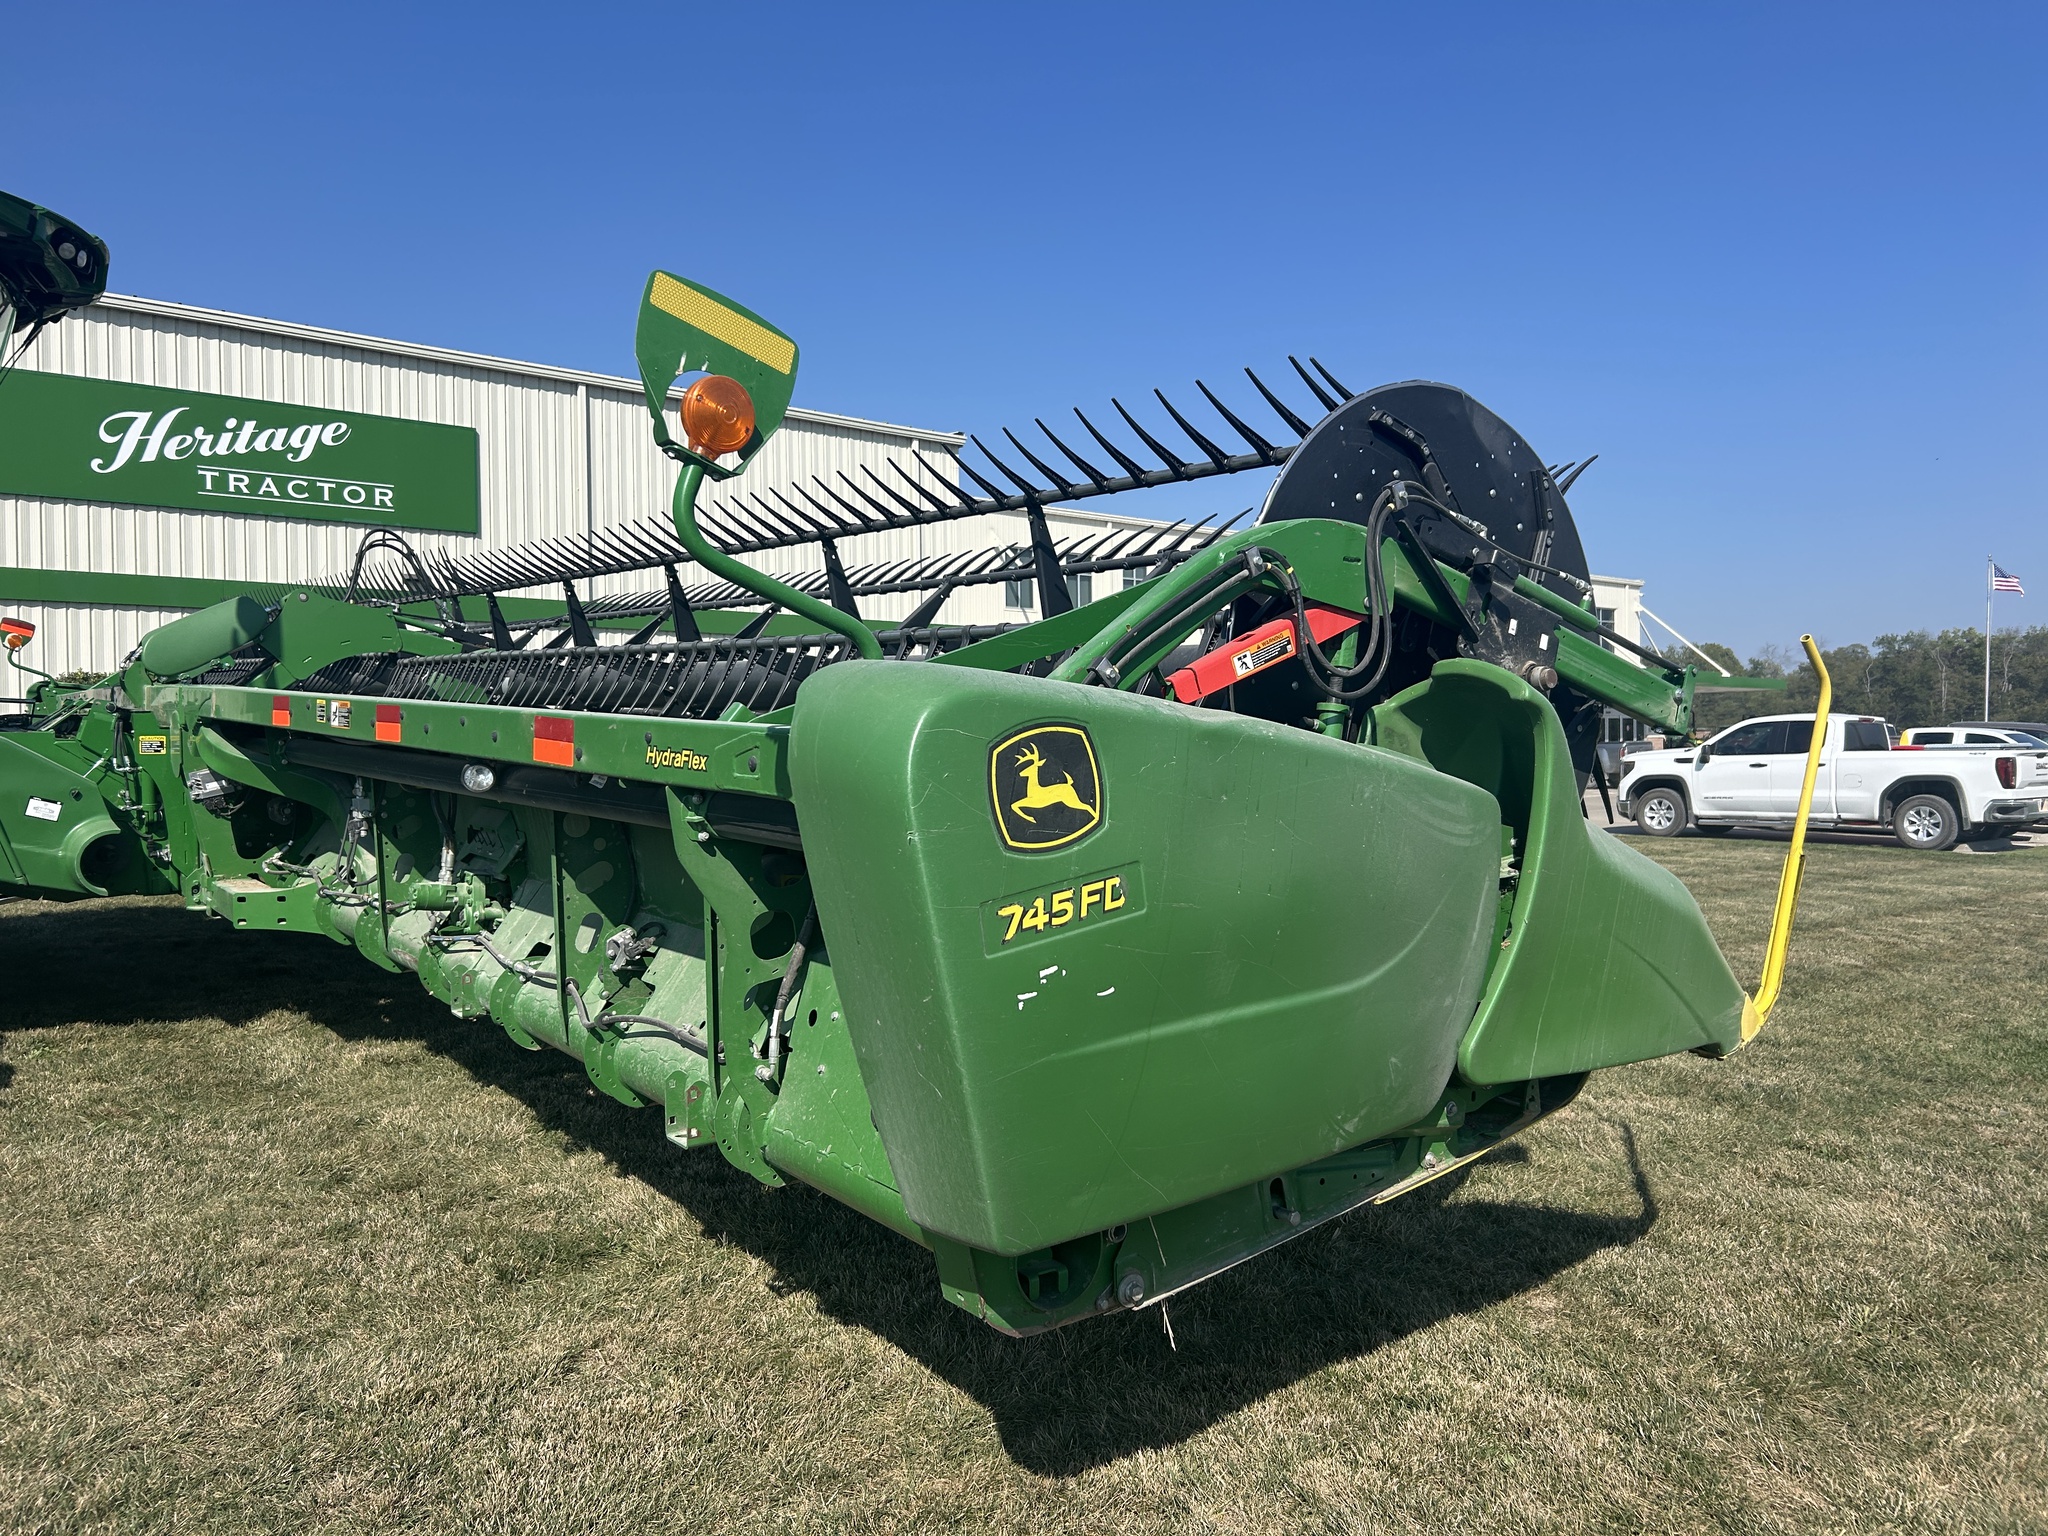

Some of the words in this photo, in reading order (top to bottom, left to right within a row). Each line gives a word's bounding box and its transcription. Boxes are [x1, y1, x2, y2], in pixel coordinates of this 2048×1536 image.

[91, 407, 351, 473] Heritage
[200, 469, 394, 506] TRACTOR
[645, 745, 709, 771] HydraFlex
